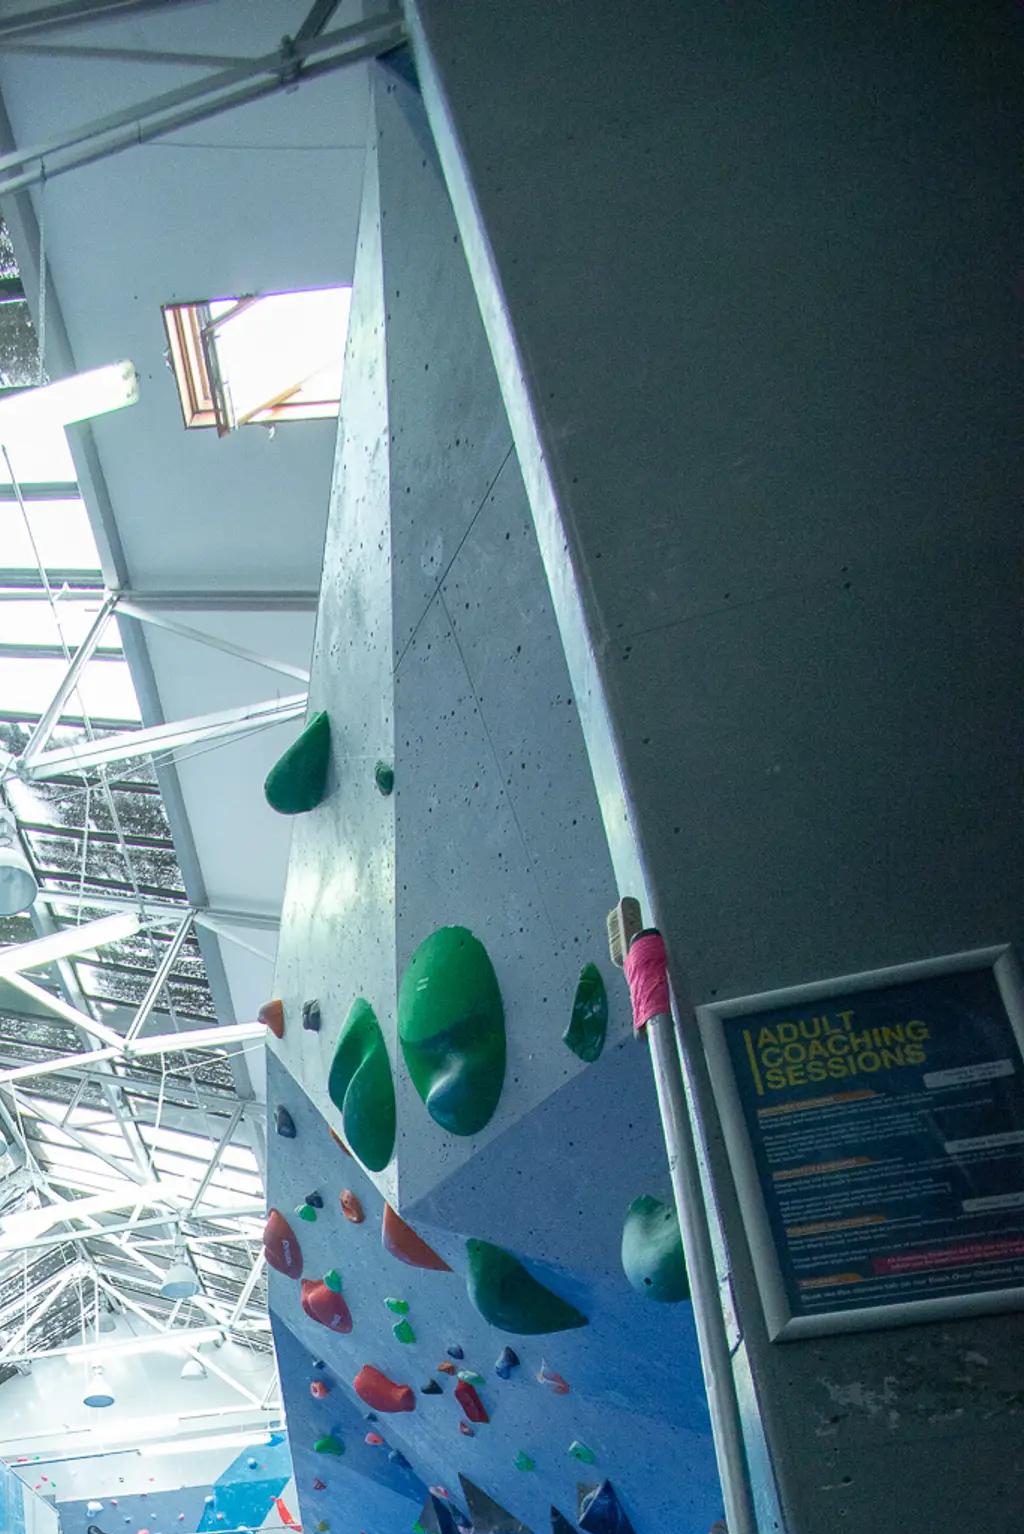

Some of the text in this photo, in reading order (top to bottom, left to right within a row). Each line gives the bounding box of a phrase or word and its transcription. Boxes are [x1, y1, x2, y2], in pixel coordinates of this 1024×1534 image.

[757, 1010, 856, 1048] ADULT
[761, 1020, 931, 1068] COACHING
[765, 1043, 927, 1090] SESSIONS
